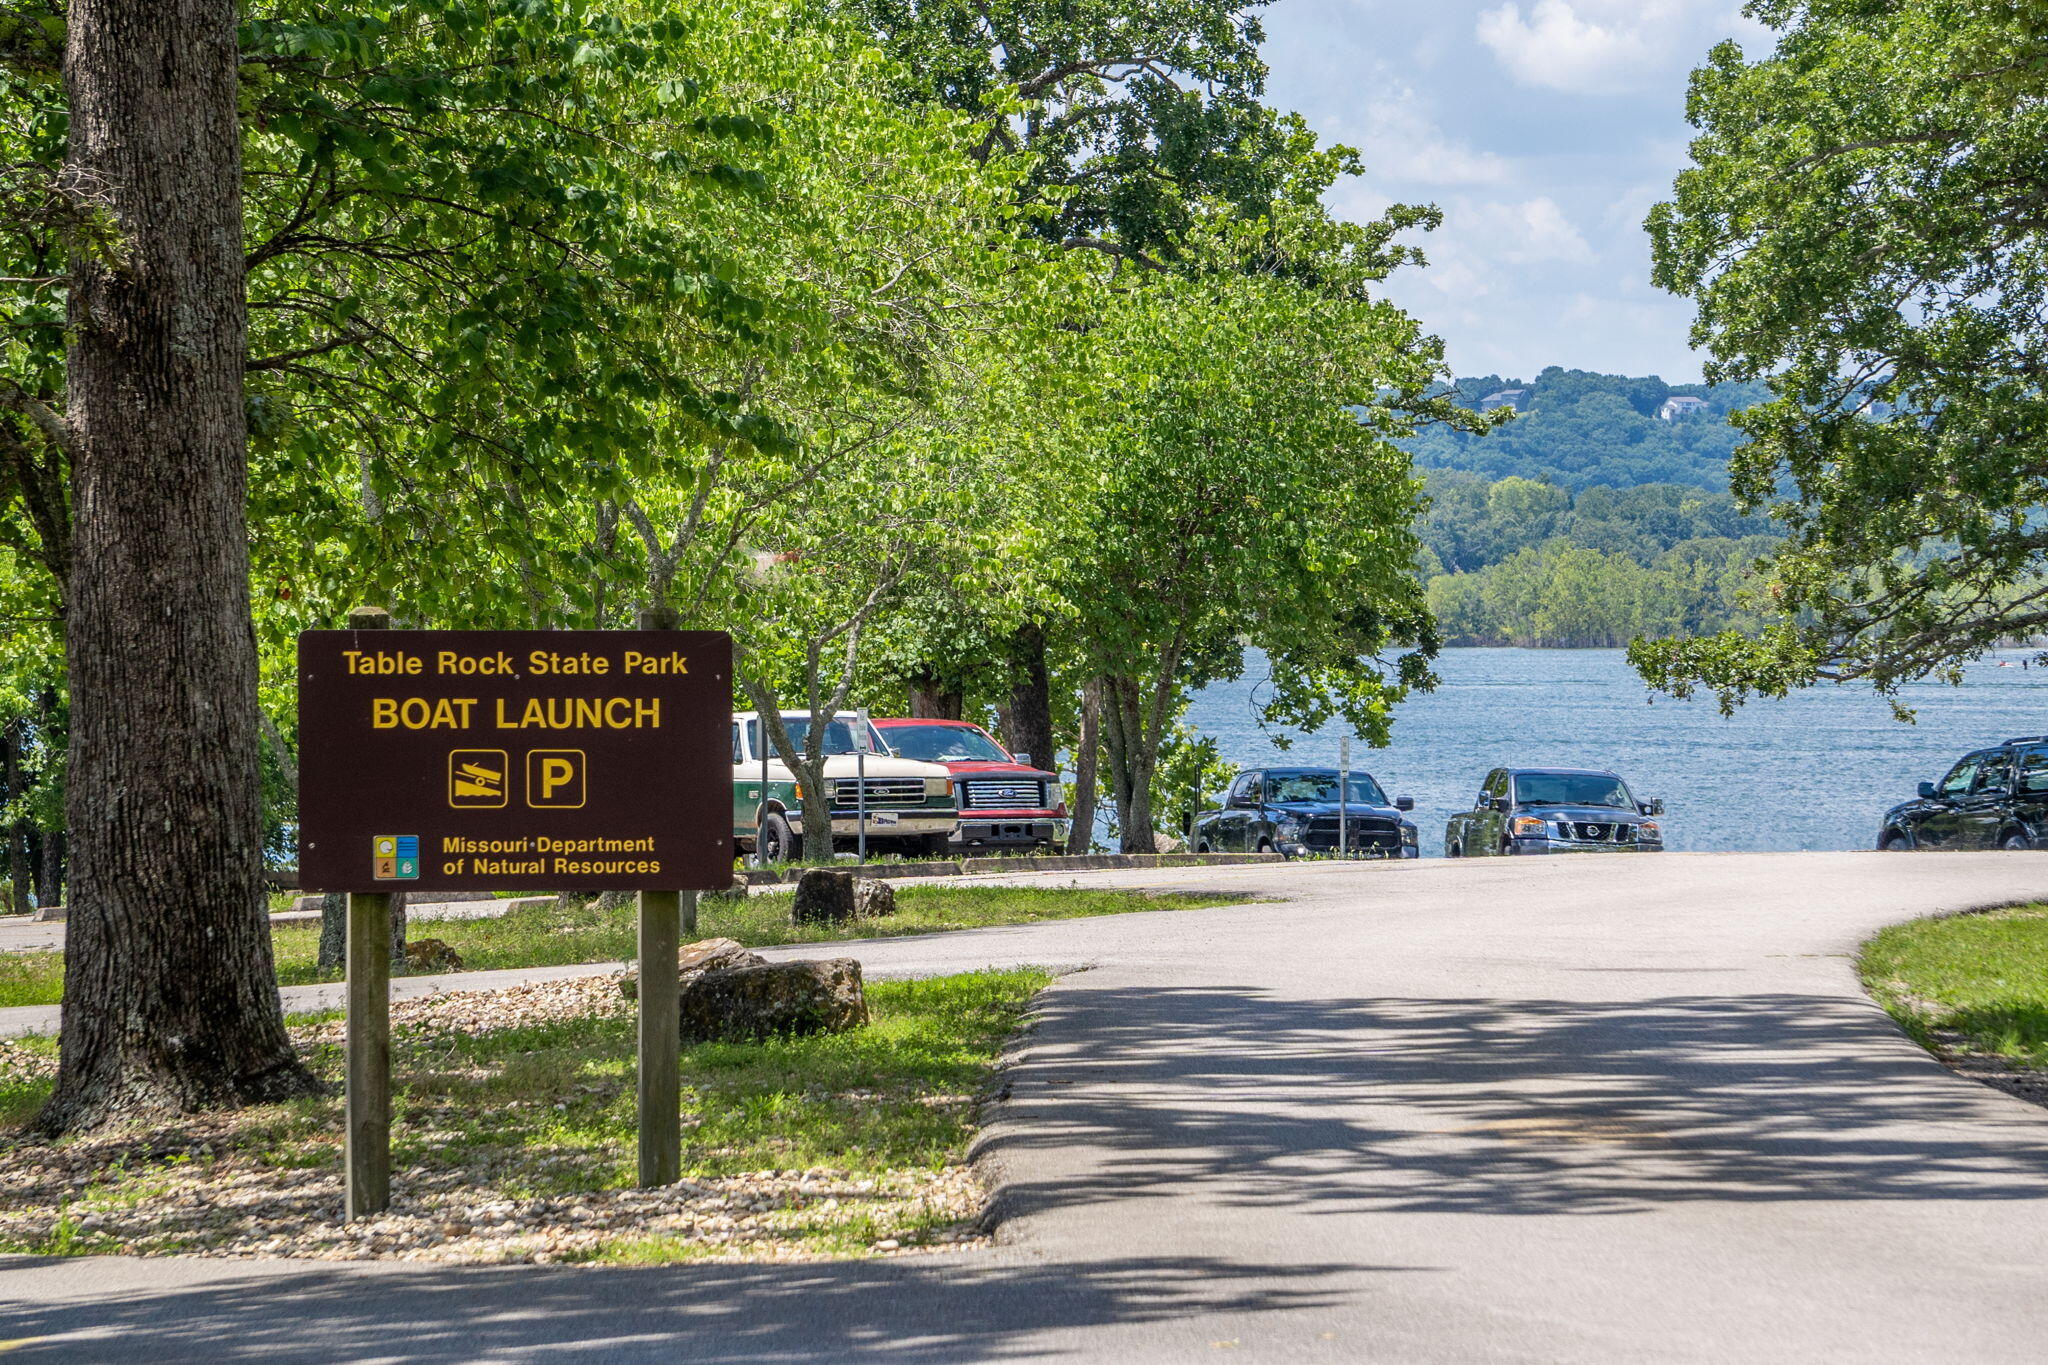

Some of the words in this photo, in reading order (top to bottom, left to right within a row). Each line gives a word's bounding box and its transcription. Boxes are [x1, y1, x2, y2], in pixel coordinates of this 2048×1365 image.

[342, 650, 423, 675] Table
[437, 651, 514, 675] Rock
[528, 650, 610, 675] State
[624, 651, 689, 675] Park
[373, 698, 478, 730] BOAT
[496, 697, 661, 730] LAUNCH
[542, 758, 574, 799] P
[443, 836, 528, 854] Missouri
[537, 836, 655, 856] Department
[443, 858, 465, 875] of
[473, 858, 545, 875] Natural
[554, 857, 661, 875] Resources
